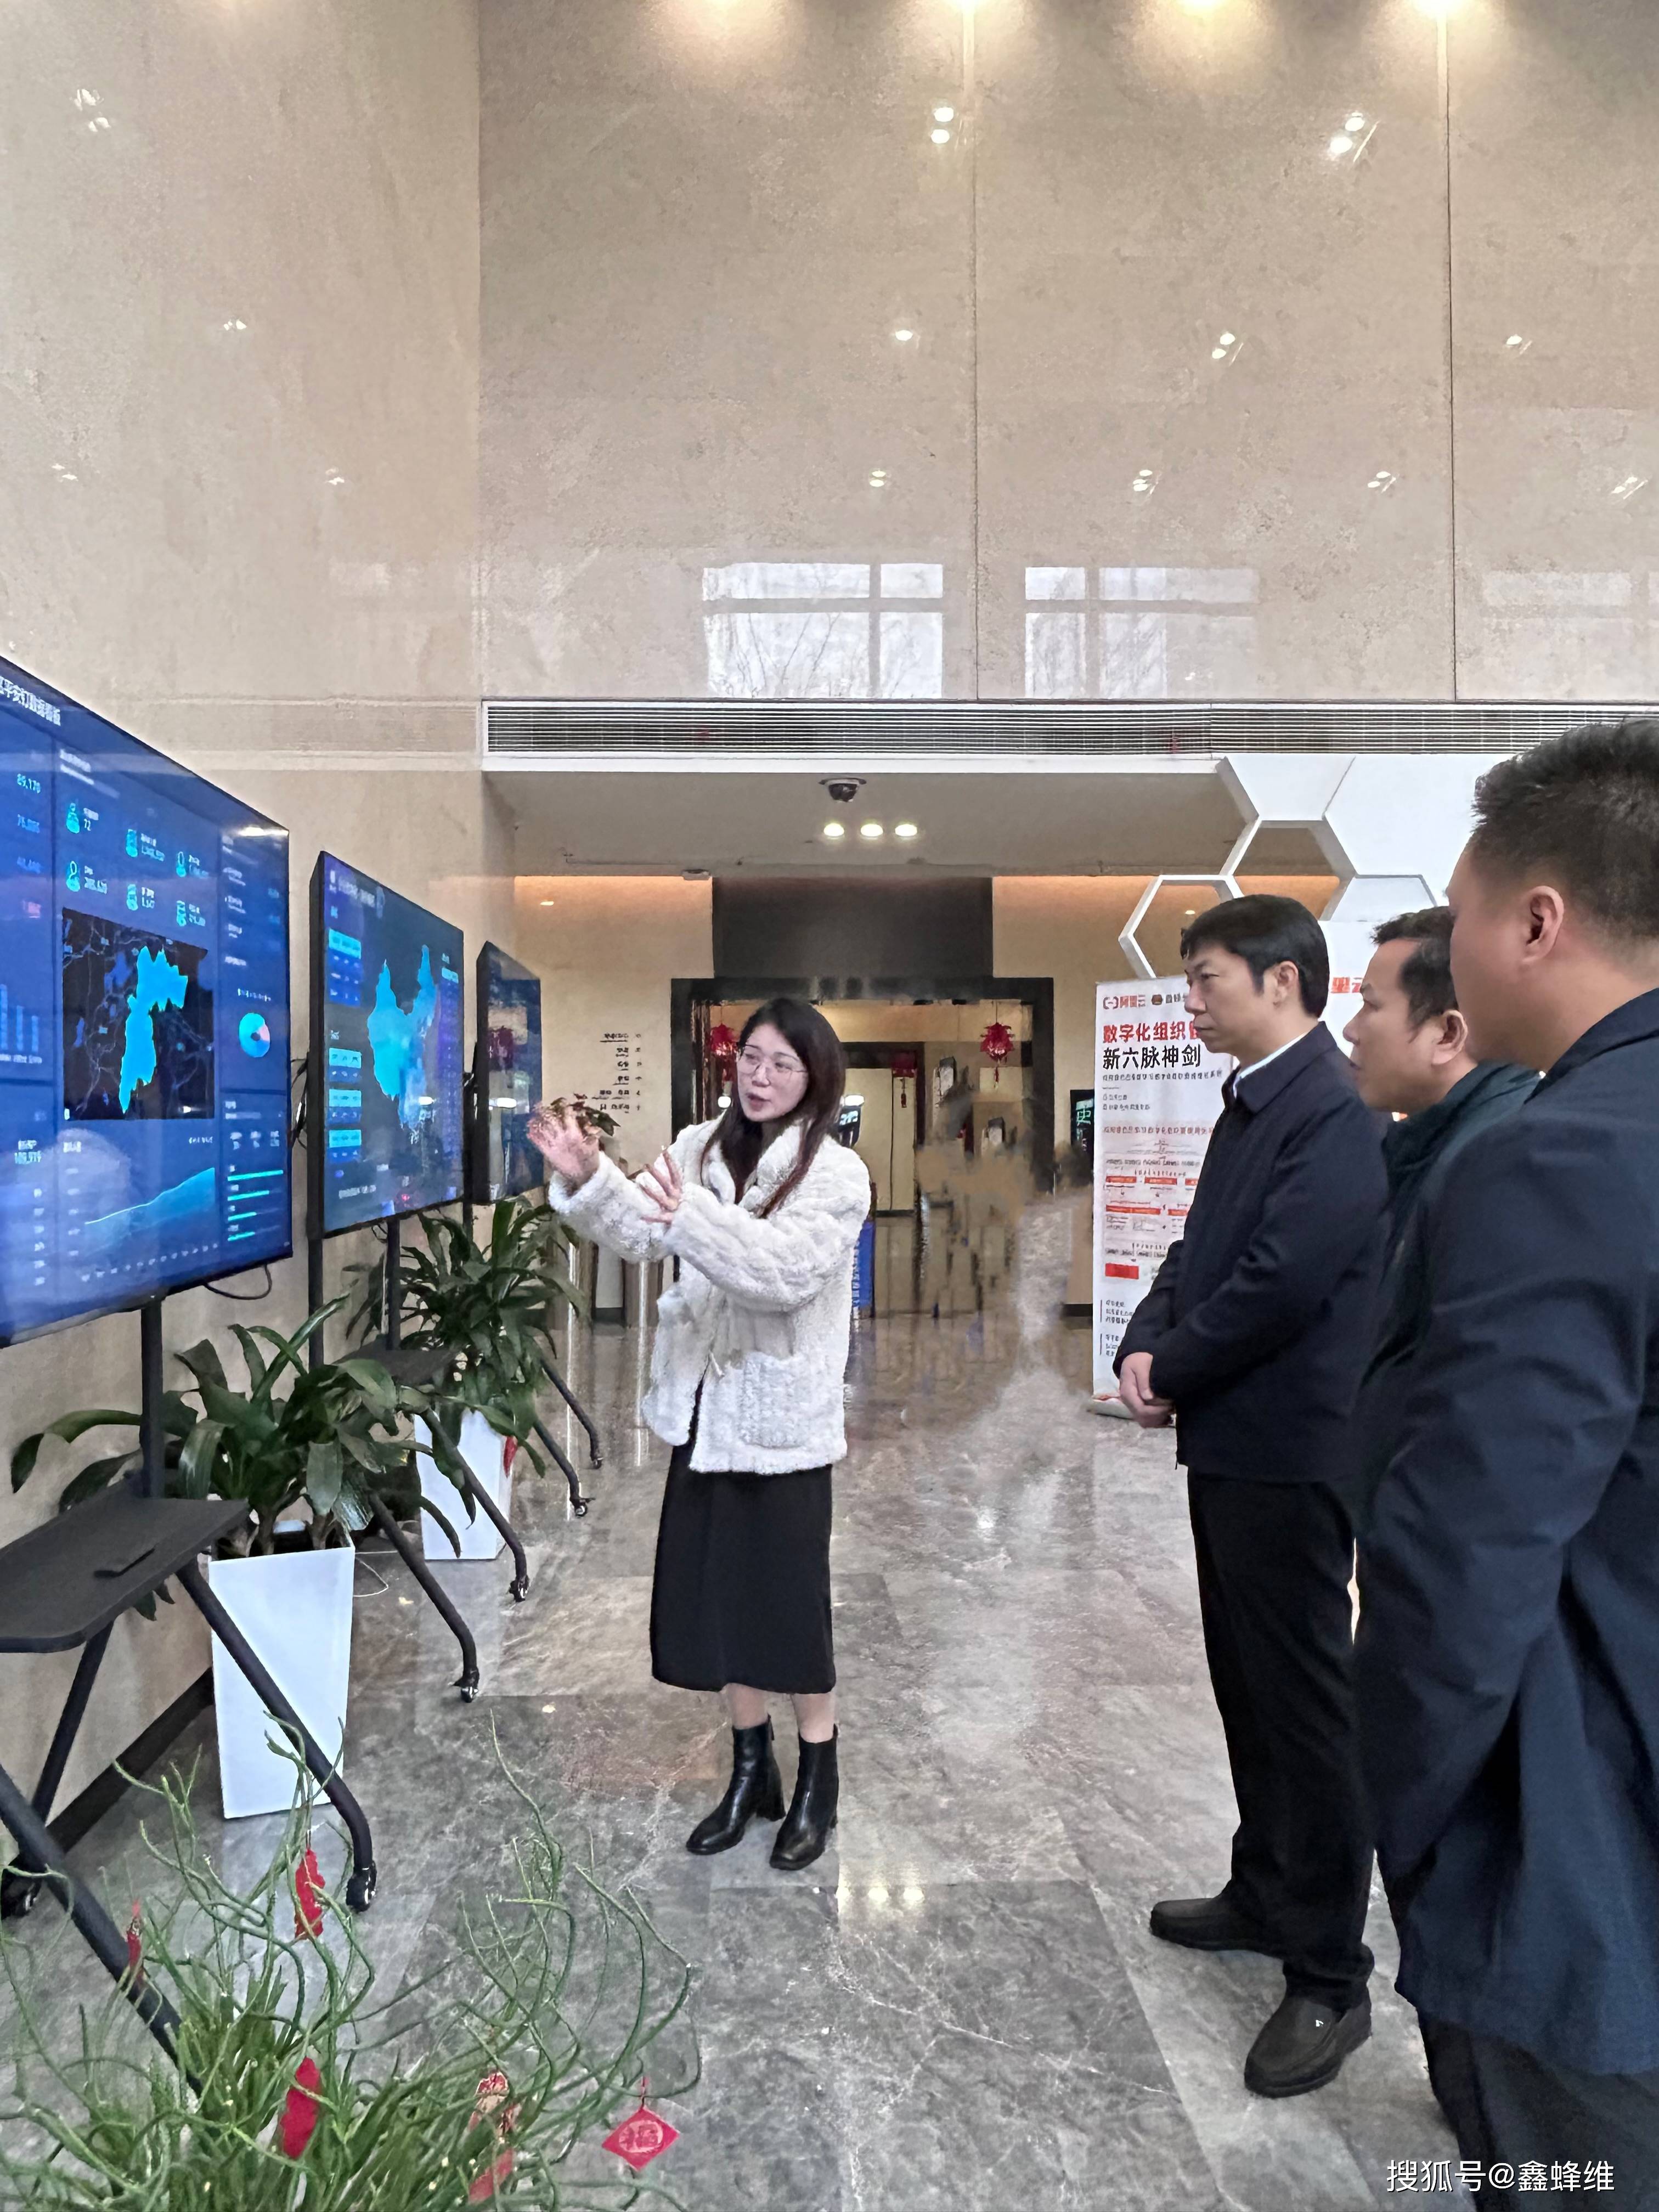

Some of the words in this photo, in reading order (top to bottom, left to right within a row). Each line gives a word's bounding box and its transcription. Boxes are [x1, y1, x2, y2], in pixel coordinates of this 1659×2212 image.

[1103, 1044, 1201, 1070] 新六脉神剑
